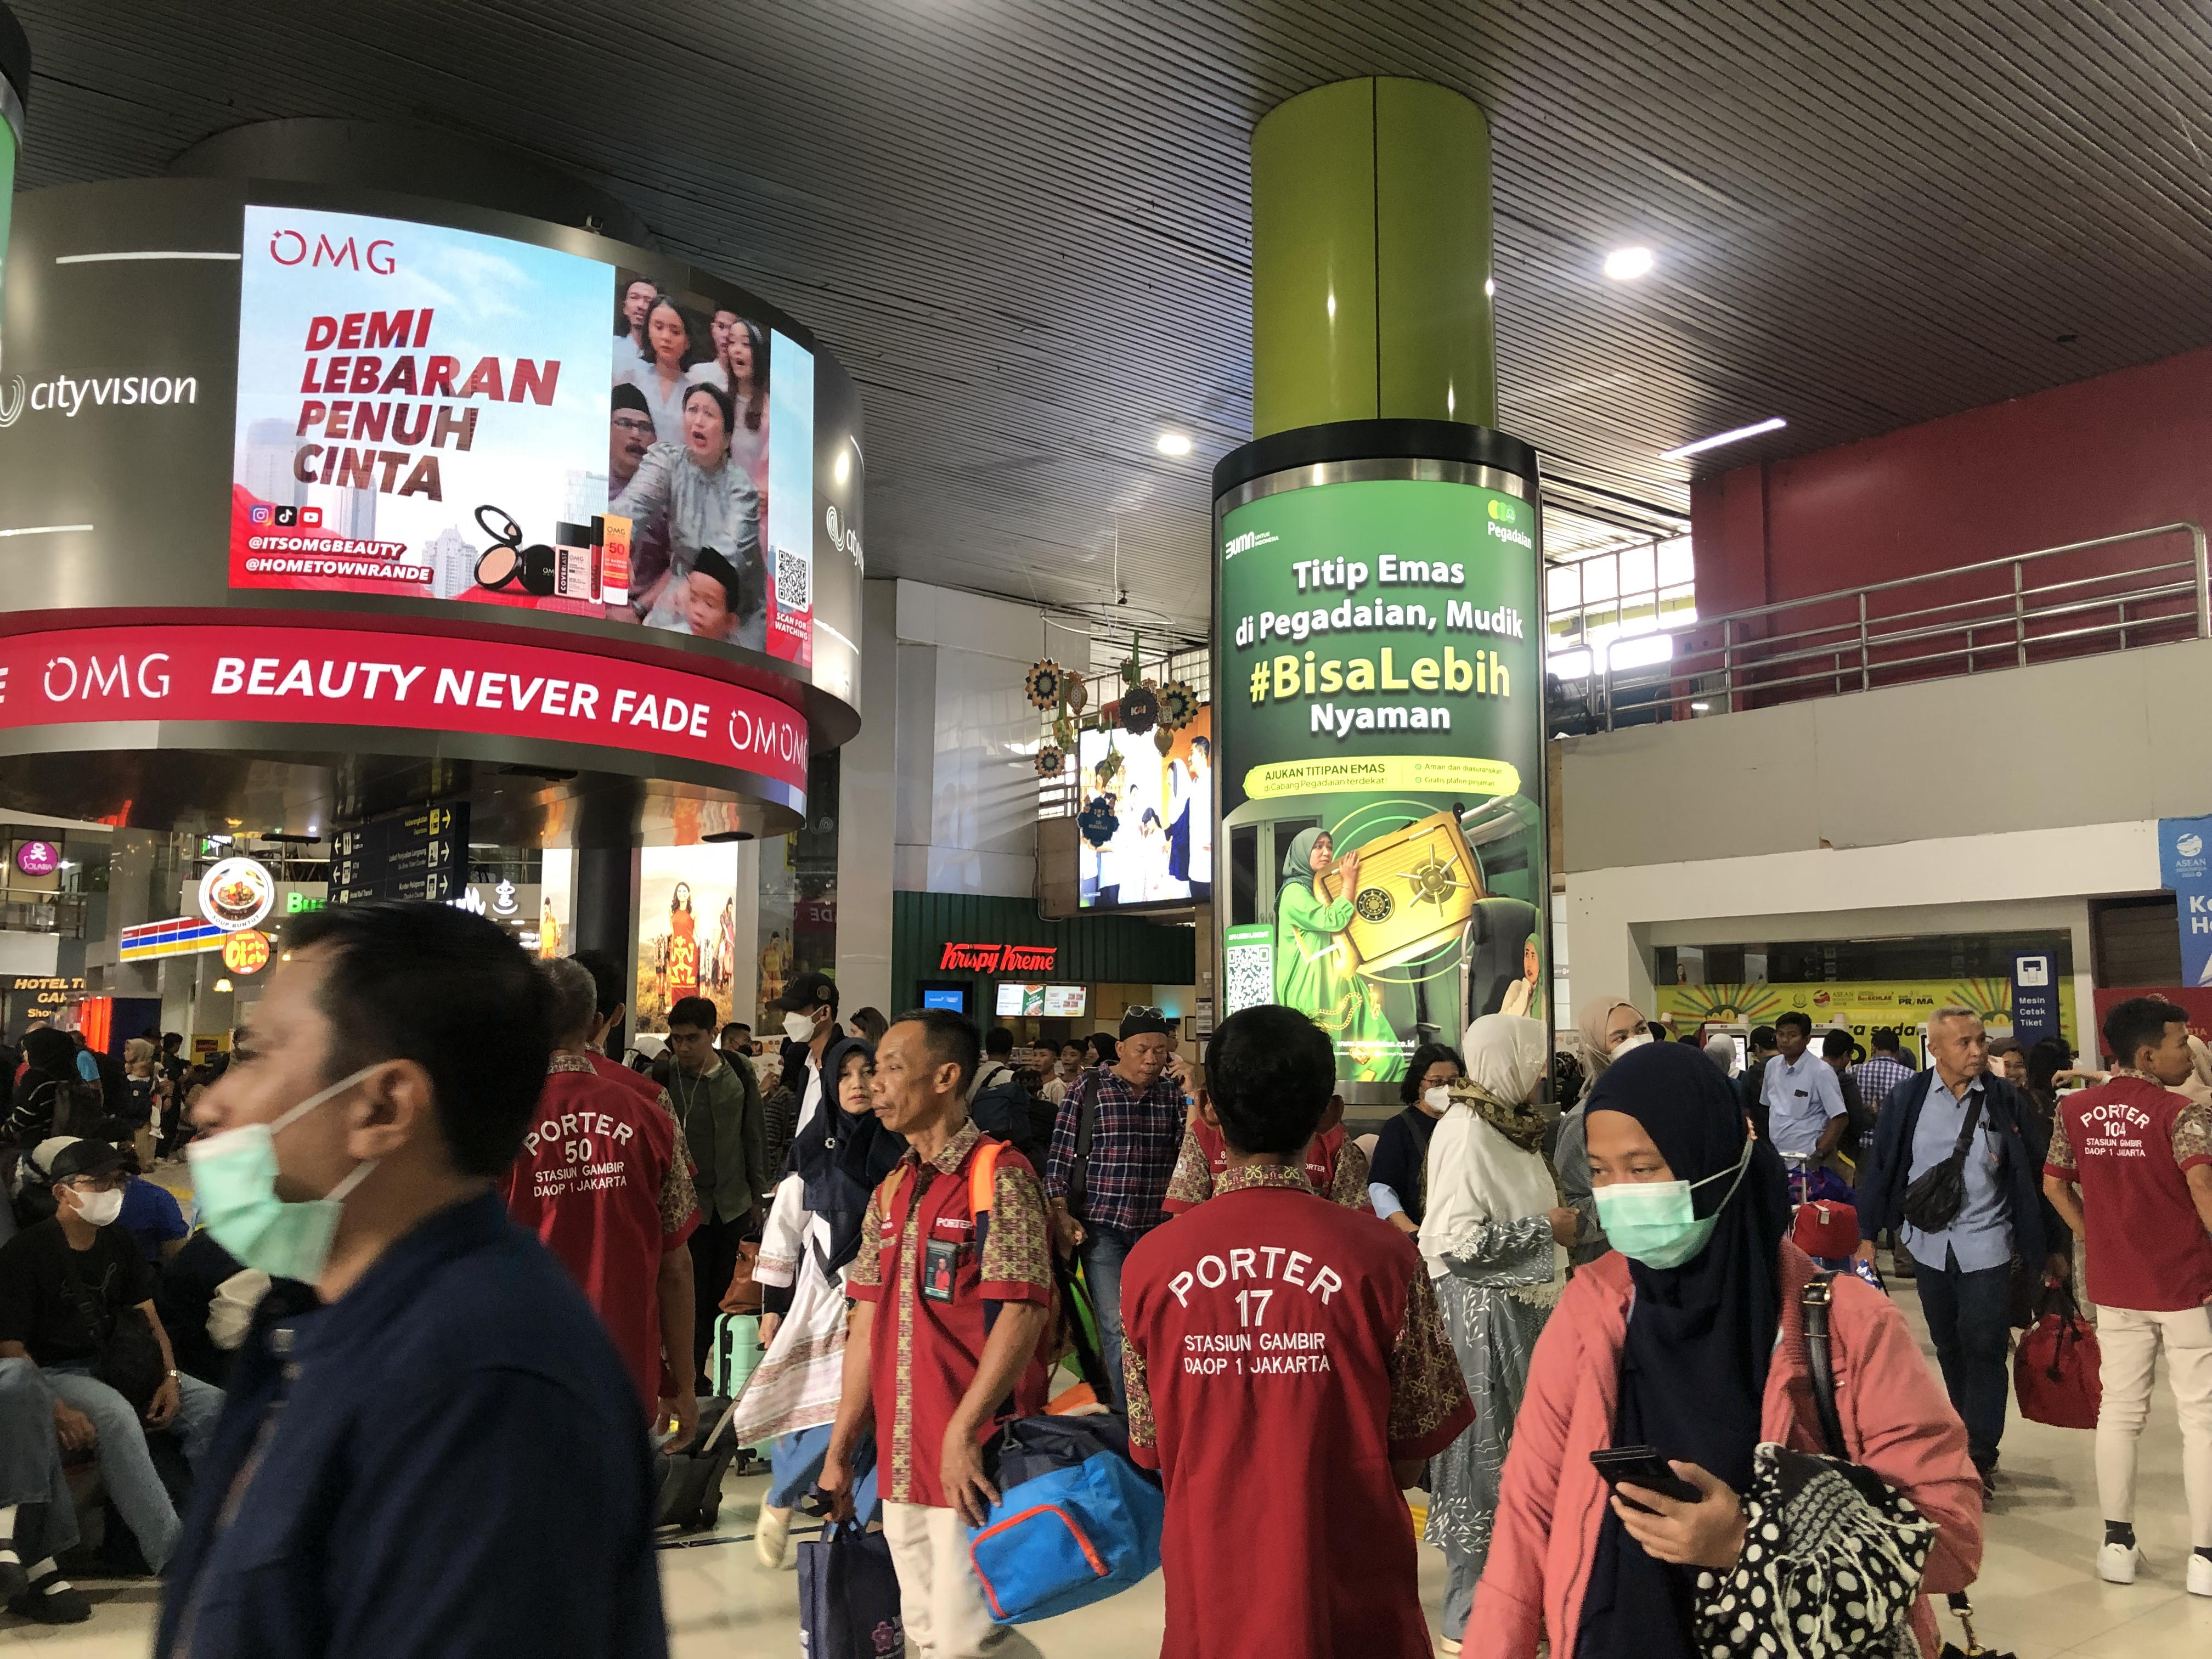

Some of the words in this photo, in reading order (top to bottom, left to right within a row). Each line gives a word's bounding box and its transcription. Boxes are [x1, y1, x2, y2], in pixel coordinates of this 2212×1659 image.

[270, 229, 395, 275] OMG
[305, 308, 434, 351] DEMI
[300, 355, 561, 406] LEBARAN
[31, 375, 196, 417] cityvision
[296, 400, 479, 452] PENUH
[293, 443, 443, 502] CINTA
[249, 537, 402, 557] @ITSOMGBEAUTY
[1255, 531, 1270, 540] UNTUK
[1255, 535, 1279, 546] INDONESIA
[1487, 521, 1532, 549] Pegadaian
[246, 558, 430, 581] @HOMETOWNRANDE
[560, 552, 568, 591] COVERLAST
[1293, 556, 1368, 590] Titip
[1379, 554, 1464, 583] Emas
[775, 620, 808, 641] WATCHING
[776, 612, 794, 624] SCAN
[795, 618, 806, 630] FOR
[1235, 616, 1254, 647] di
[1260, 597, 1437, 640] Pegadaian,
[1447, 600, 1523, 639] Mudik
[1250, 646, 1510, 703] #BisaLebih
[43, 653, 170, 702] OMG
[211, 658, 426, 701] BEAUTY
[433, 668, 599, 719] NEVER
[611, 689, 710, 738] FADE
[1311, 703, 1451, 738] Nyaman
[1265, 767, 1304, 781] AJUKAN
[1306, 765, 1348, 776] TITIPAN
[1351, 764, 1385, 774] EMAS
[1271, 781, 1300, 791] Cabang
[1301, 778, 1345, 789] Pegadaian
[2176, 859, 2206, 867] ASEAN
[212, 915, 229, 927] SOUP
[232, 915, 259, 928] BUNTUT
[940, 943, 1002, 973] Krispy
[1000, 945, 1057, 971] Kreme
[14, 978, 69, 990] HOTEL
[27, 1008, 52, 1018] Sho
[2080, 1104, 2150, 1130] PORTER
[2103, 1121, 2126, 1137] 104
[523, 1112, 633, 1156] PORTER
[2086, 1138, 2117, 1147] STASIUN
[565, 1138, 592, 1164] 50
[2085, 1147, 2106, 1155] DAOP
[2109, 1148, 2113, 1156] 1
[535, 1166, 578, 1183] STASIUN
[582, 1162, 624, 1176] GAMBIR
[533, 1184, 566, 1197] DAOP
[570, 1182, 575, 1194] 1
[577, 1176, 627, 1192] JAKARTA
[1167, 1246, 1342, 1308] PORTER
[1234, 1289, 1273, 1327] 17
[1184, 1334, 1251, 1352] STASIUN
[1260, 1333, 1325, 1350] GAMBIR
[1183, 1357, 1227, 1375] DAOP
[1235, 1358, 1242, 1374] 1
[1250, 1355, 1331, 1374] JAKARTA
